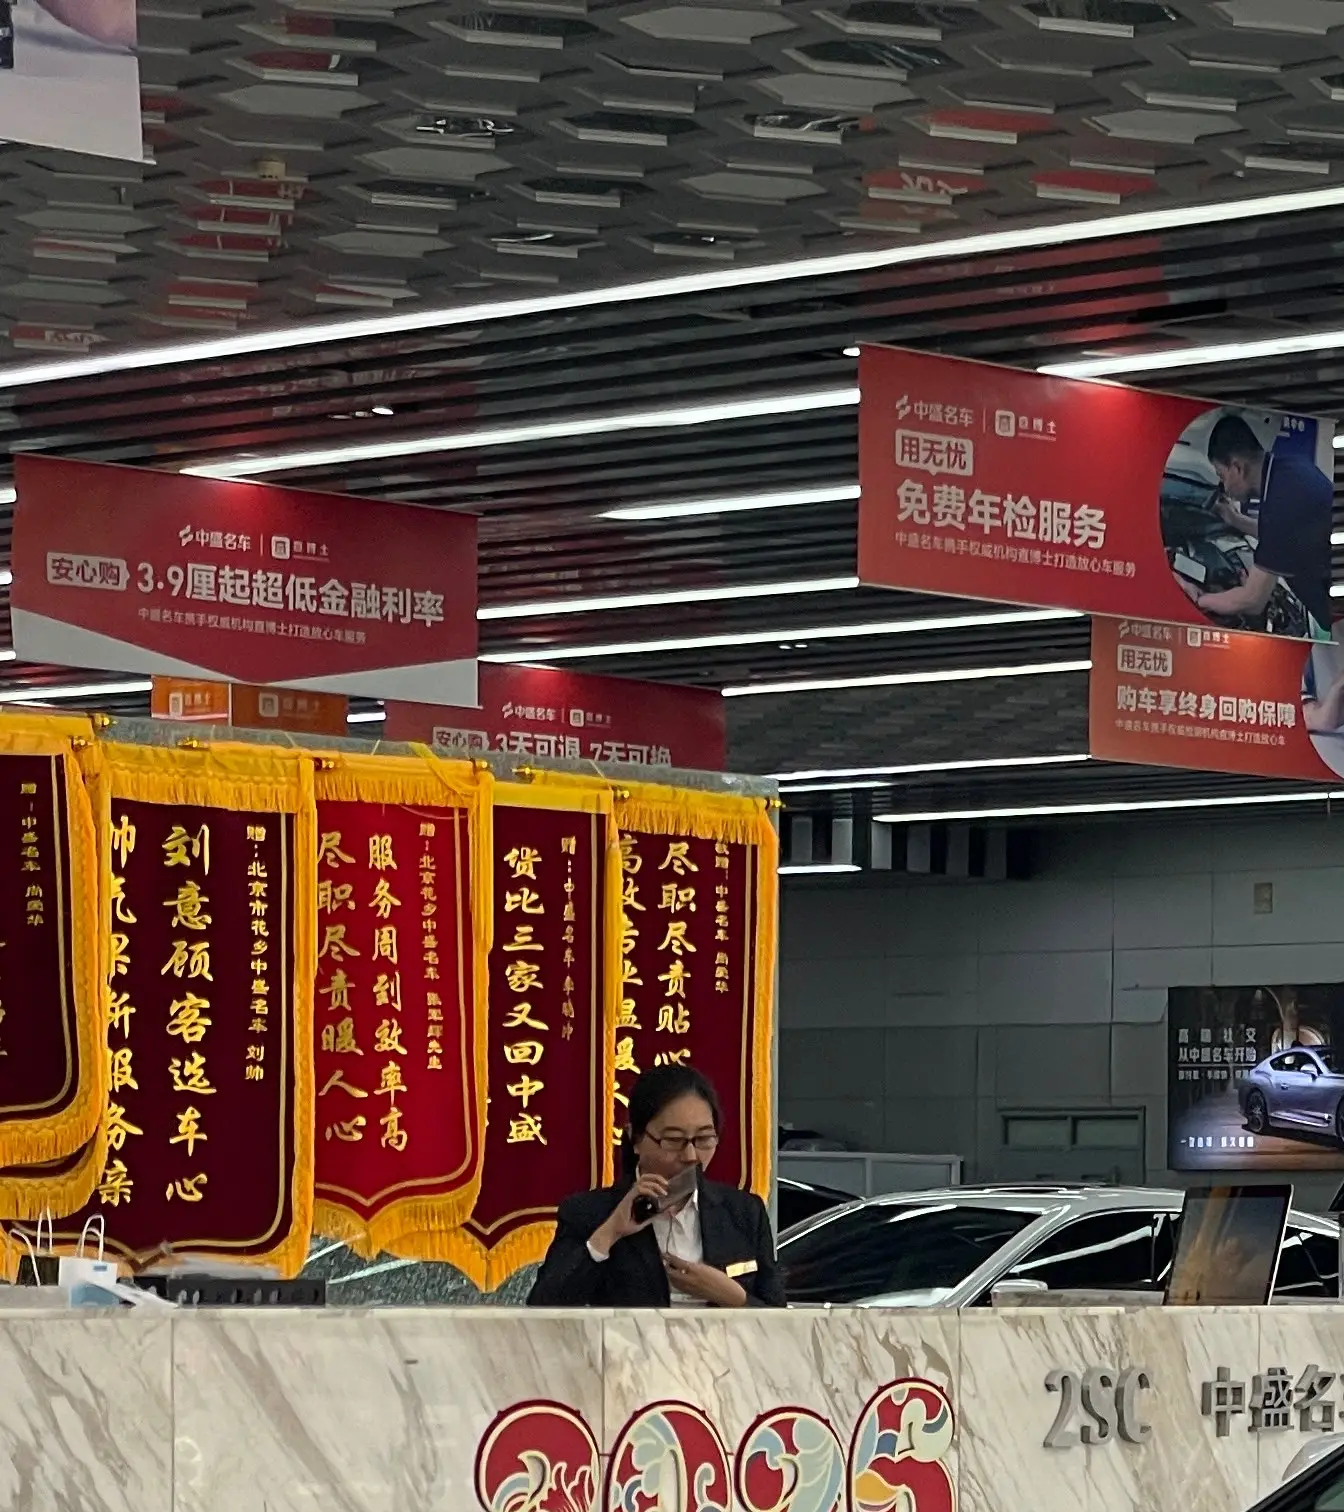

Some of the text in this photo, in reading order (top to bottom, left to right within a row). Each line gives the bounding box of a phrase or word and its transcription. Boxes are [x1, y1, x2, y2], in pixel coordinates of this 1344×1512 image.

[913, 400, 974, 427] 中盛名车
[900, 434, 967, 471] 用无忧
[896, 478, 1107, 550] 免费年检服务
[195, 529, 252, 553] 中盛名车
[51, 557, 122, 587] 安心购
[1120, 647, 1168, 673] 用无忧
[1116, 684, 1297, 729] 购车享终身回购保障
[317, 830, 369, 1142] 尽职尽责暖人心
[367, 833, 409, 1152] 服务周到效率高
[1042, 1364, 1152, 1448] 2SC
